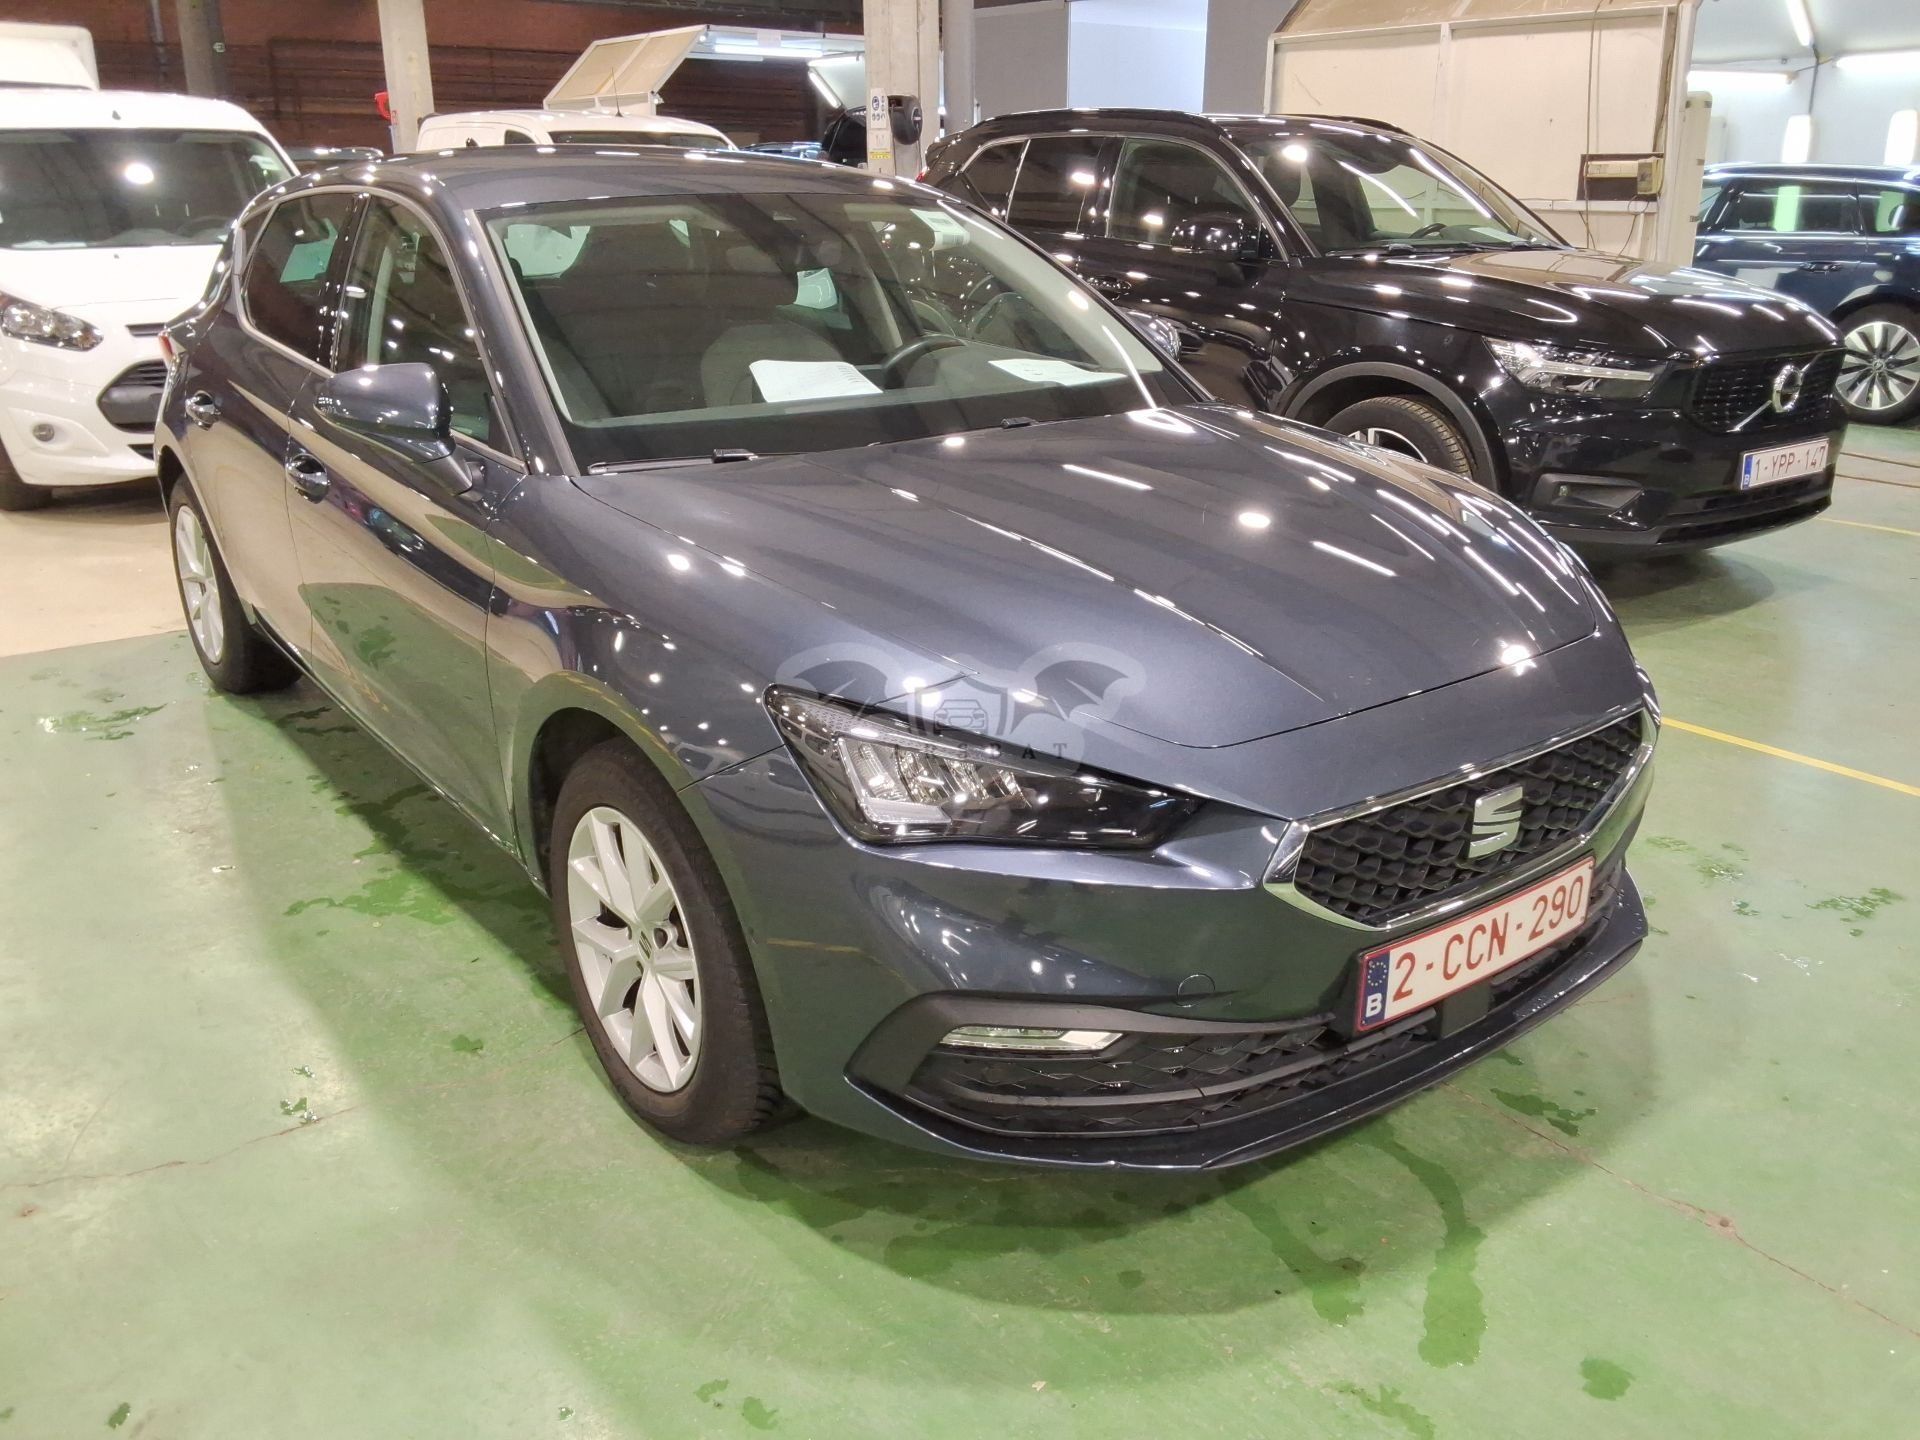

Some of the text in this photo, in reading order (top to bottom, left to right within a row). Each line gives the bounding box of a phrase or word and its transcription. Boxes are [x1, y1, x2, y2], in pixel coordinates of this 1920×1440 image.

[1756, 445, 1826, 480] 1-YPP-147
[1392, 875, 1583, 1002] 2-CCN-290
[1365, 995, 1382, 1017] B
